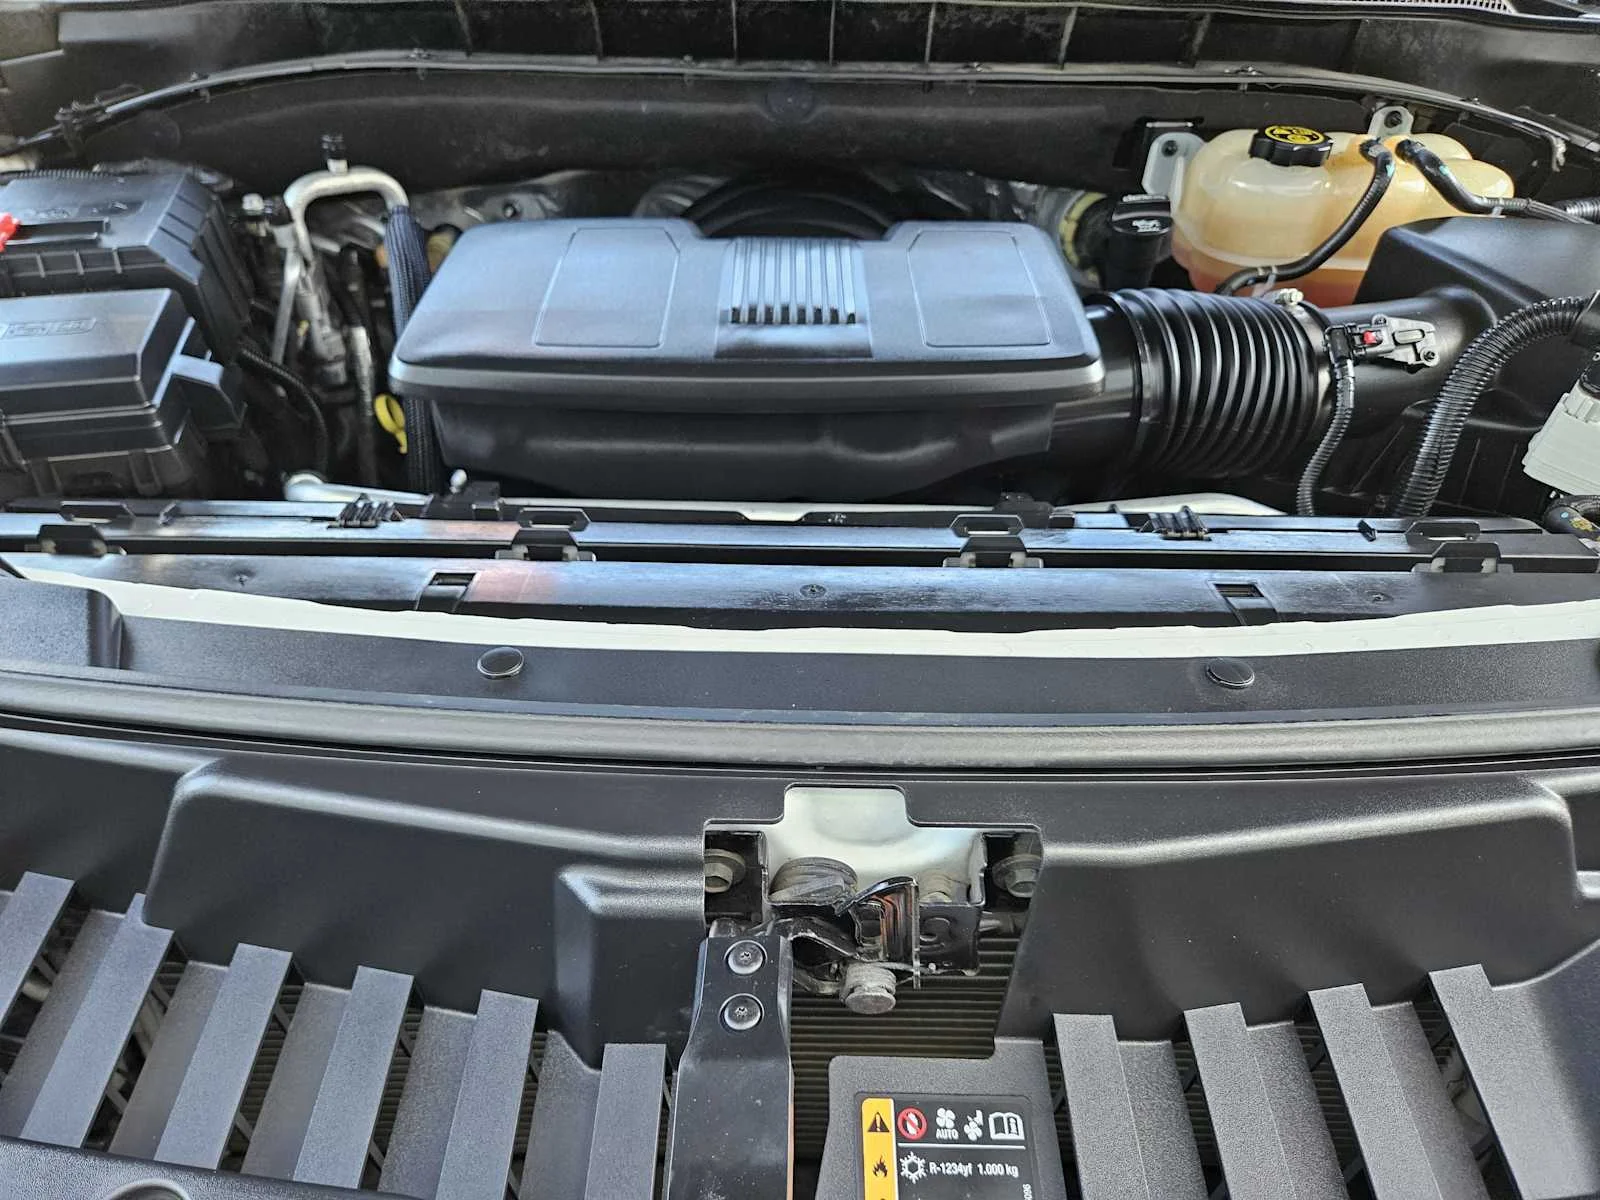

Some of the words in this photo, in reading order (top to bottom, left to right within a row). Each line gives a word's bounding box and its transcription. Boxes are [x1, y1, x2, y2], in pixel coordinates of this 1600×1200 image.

[936, 1128, 959, 1140] AUTO
[929, 1162, 972, 1177] R-1234yf
[977, 1163, 1004, 1176] 1.000
[1005, 1164, 1018, 1178] kg
[1022, 1183, 1032, 1200] 096
